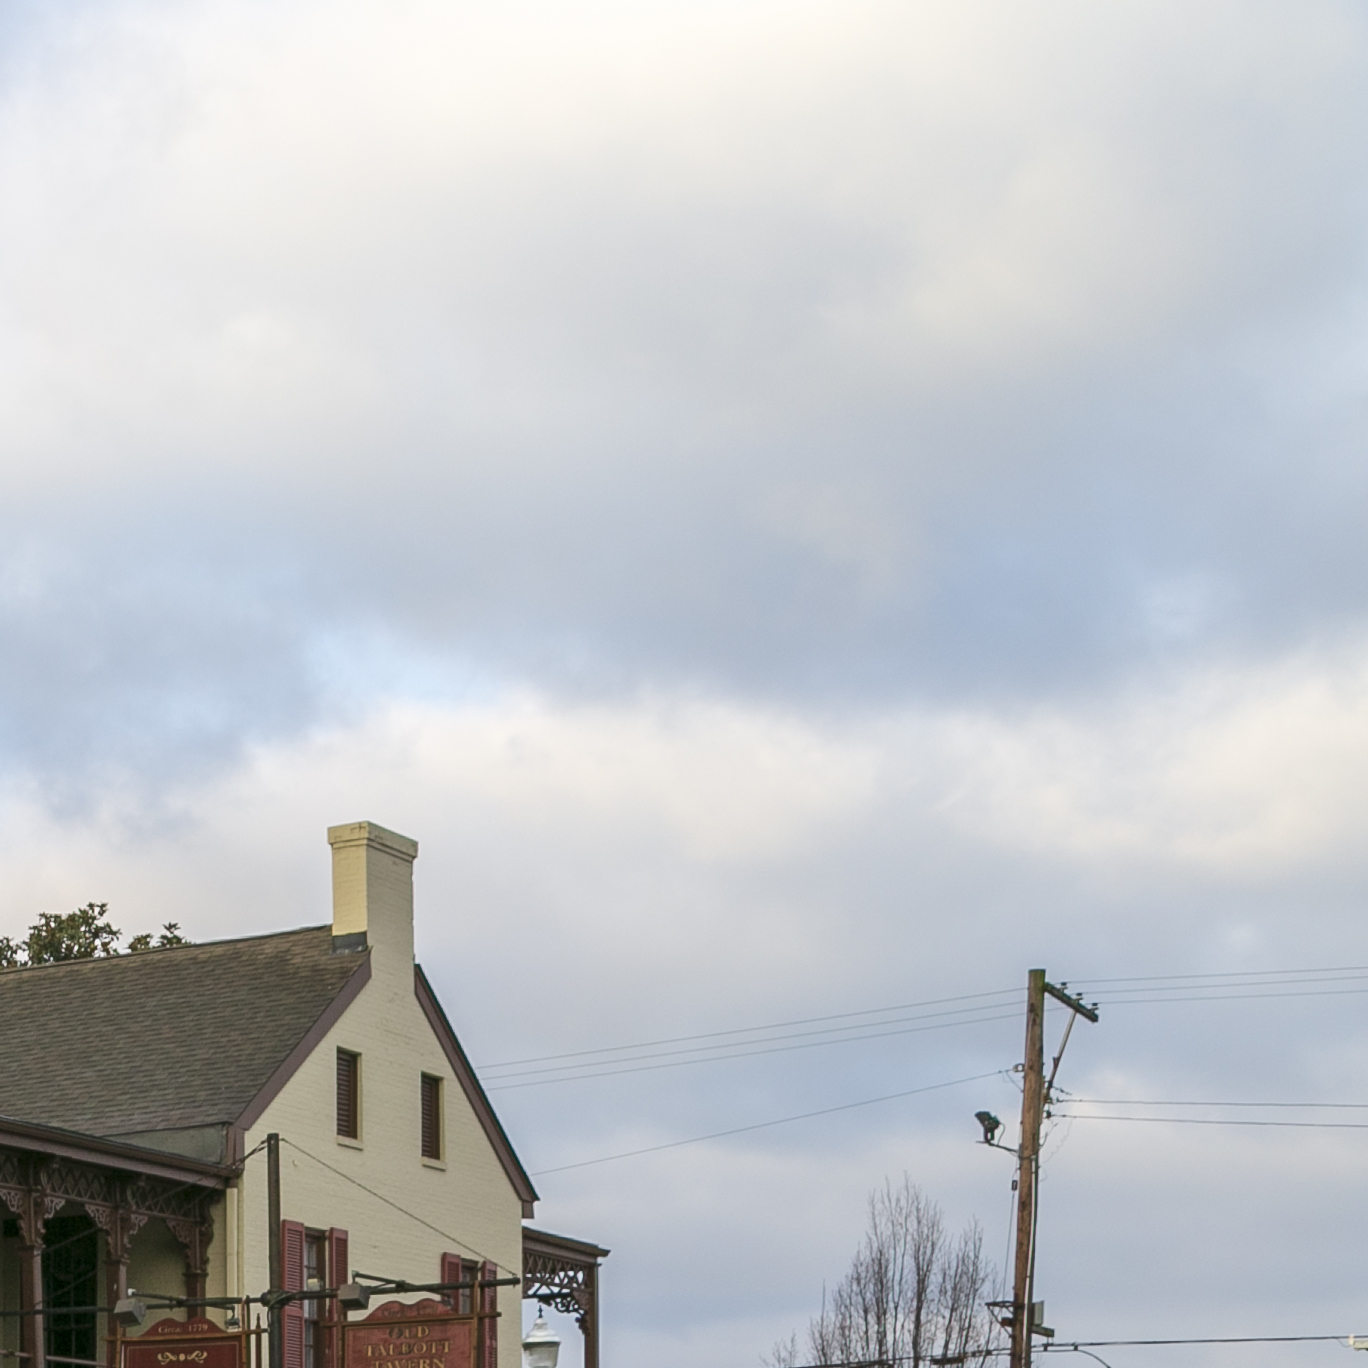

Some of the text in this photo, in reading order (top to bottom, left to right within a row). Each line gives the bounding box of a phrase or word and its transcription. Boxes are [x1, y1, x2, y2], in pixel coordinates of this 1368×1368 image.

[188, 1323, 208, 1333] 1779
[388, 1325, 429, 1340] OLD
[365, 1341, 453, 1358] TALBOTT
